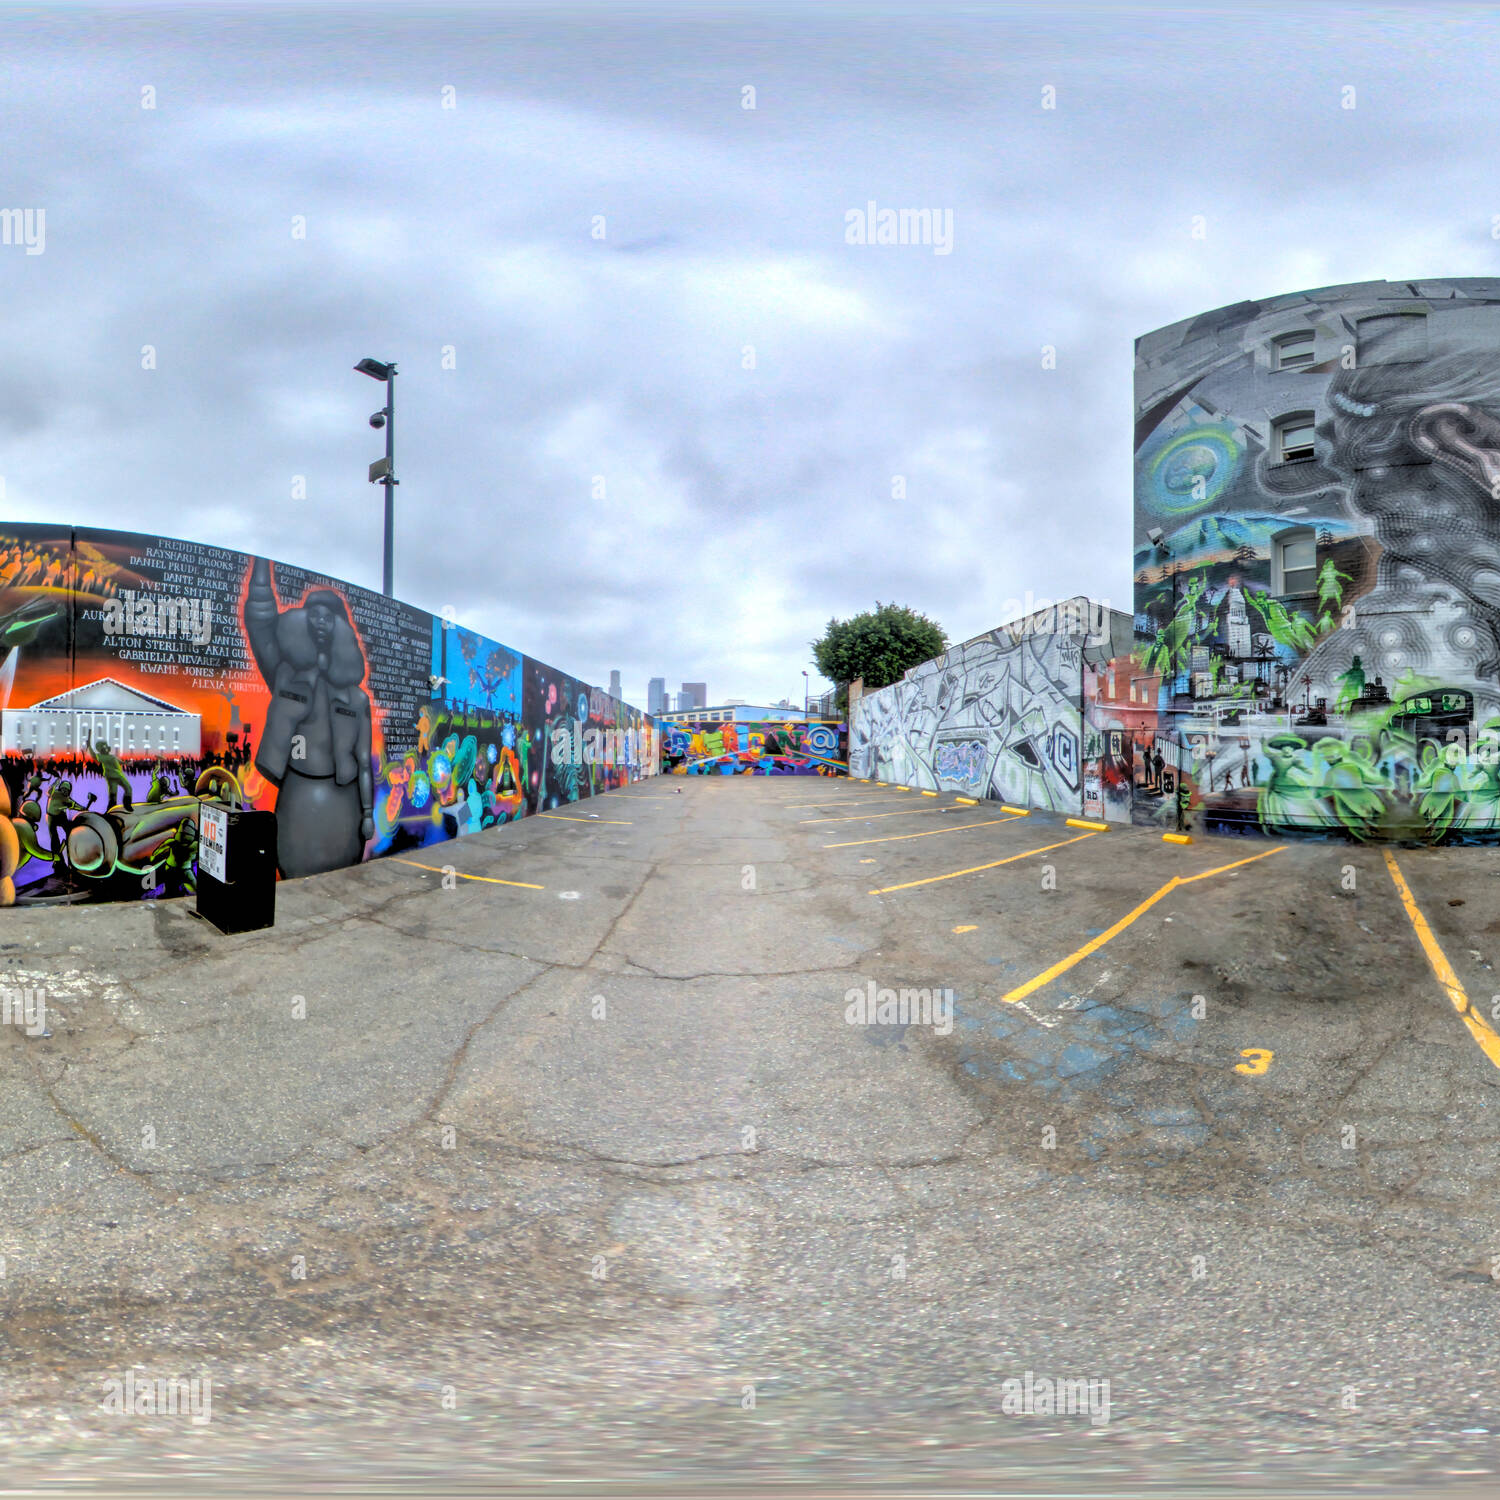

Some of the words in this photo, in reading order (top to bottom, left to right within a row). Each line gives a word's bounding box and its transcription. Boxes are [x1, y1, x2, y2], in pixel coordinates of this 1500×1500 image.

[146, 547, 195, 563] RAYSHARD
[198, 556, 233, 571] BROOKS
[158, 539, 205, 555] FREDDIE
[208, 549, 232, 560] GRAY
[130, 556, 166, 569] DANIEL
[139, 580, 181, 594] YVETTE
[184, 586, 216, 600] SMITH
[163, 572, 193, 585] DANTE
[197, 577, 228, 591] PARKER
[118, 588, 171, 603] PHILANDO
[82, 609, 113, 622] AURA
[119, 612, 160, 626] ROSSER
[132, 627, 177, 641] BOTHAM
[102, 635, 142, 649] ALTON
[205, 645, 230, 658] AKAI
[118, 649, 175, 664] GABRIELLA
[178, 654, 221, 668] NEVAREZ
[140, 662, 179, 675] KWAME
[183, 665, 215, 678] JONES
[191, 679, 226, 690] ALEXIA
[204, 819, 216, 842] NO
[1235, 1048, 1274, 1076] 3
